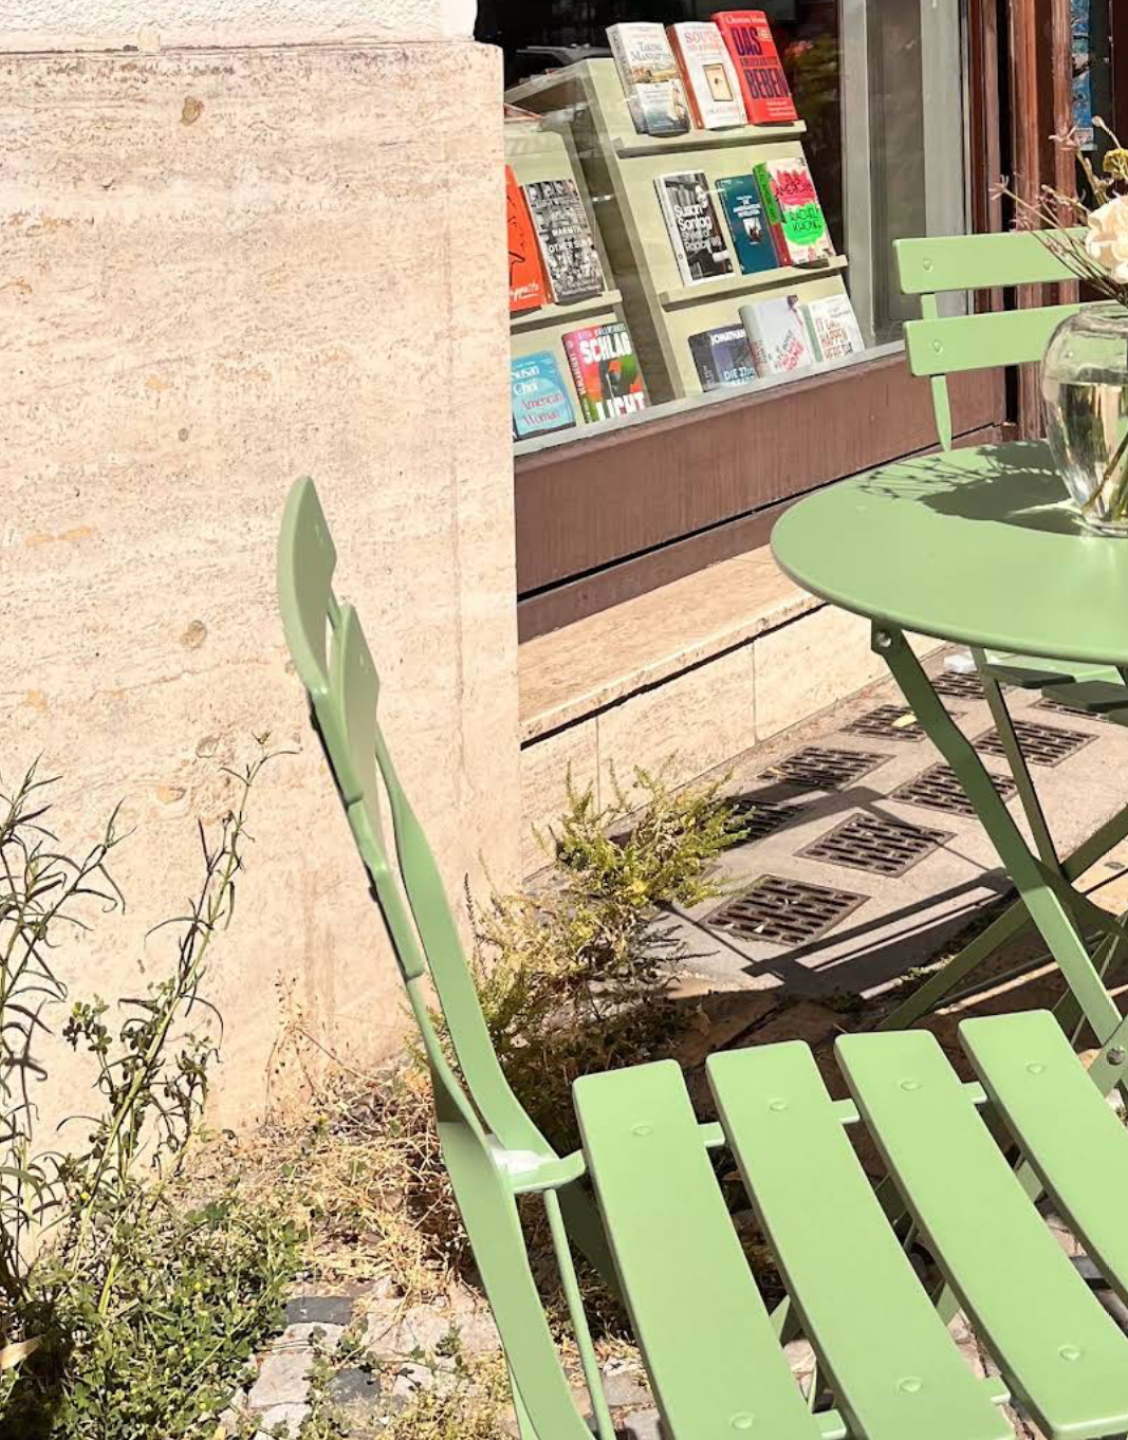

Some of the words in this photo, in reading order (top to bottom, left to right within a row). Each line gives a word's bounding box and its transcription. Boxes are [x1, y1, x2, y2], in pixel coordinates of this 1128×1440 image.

[730, 26, 763, 56] DAS
[674, 203, 703, 219] Susan
[678, 215, 713, 232] Sontag
[579, 331, 633, 365] SCHLAG
[513, 381, 539, 396] Choi
[520, 393, 563, 410] American
[595, 391, 646, 421] LICHT
[522, 410, 560, 426] Woman
